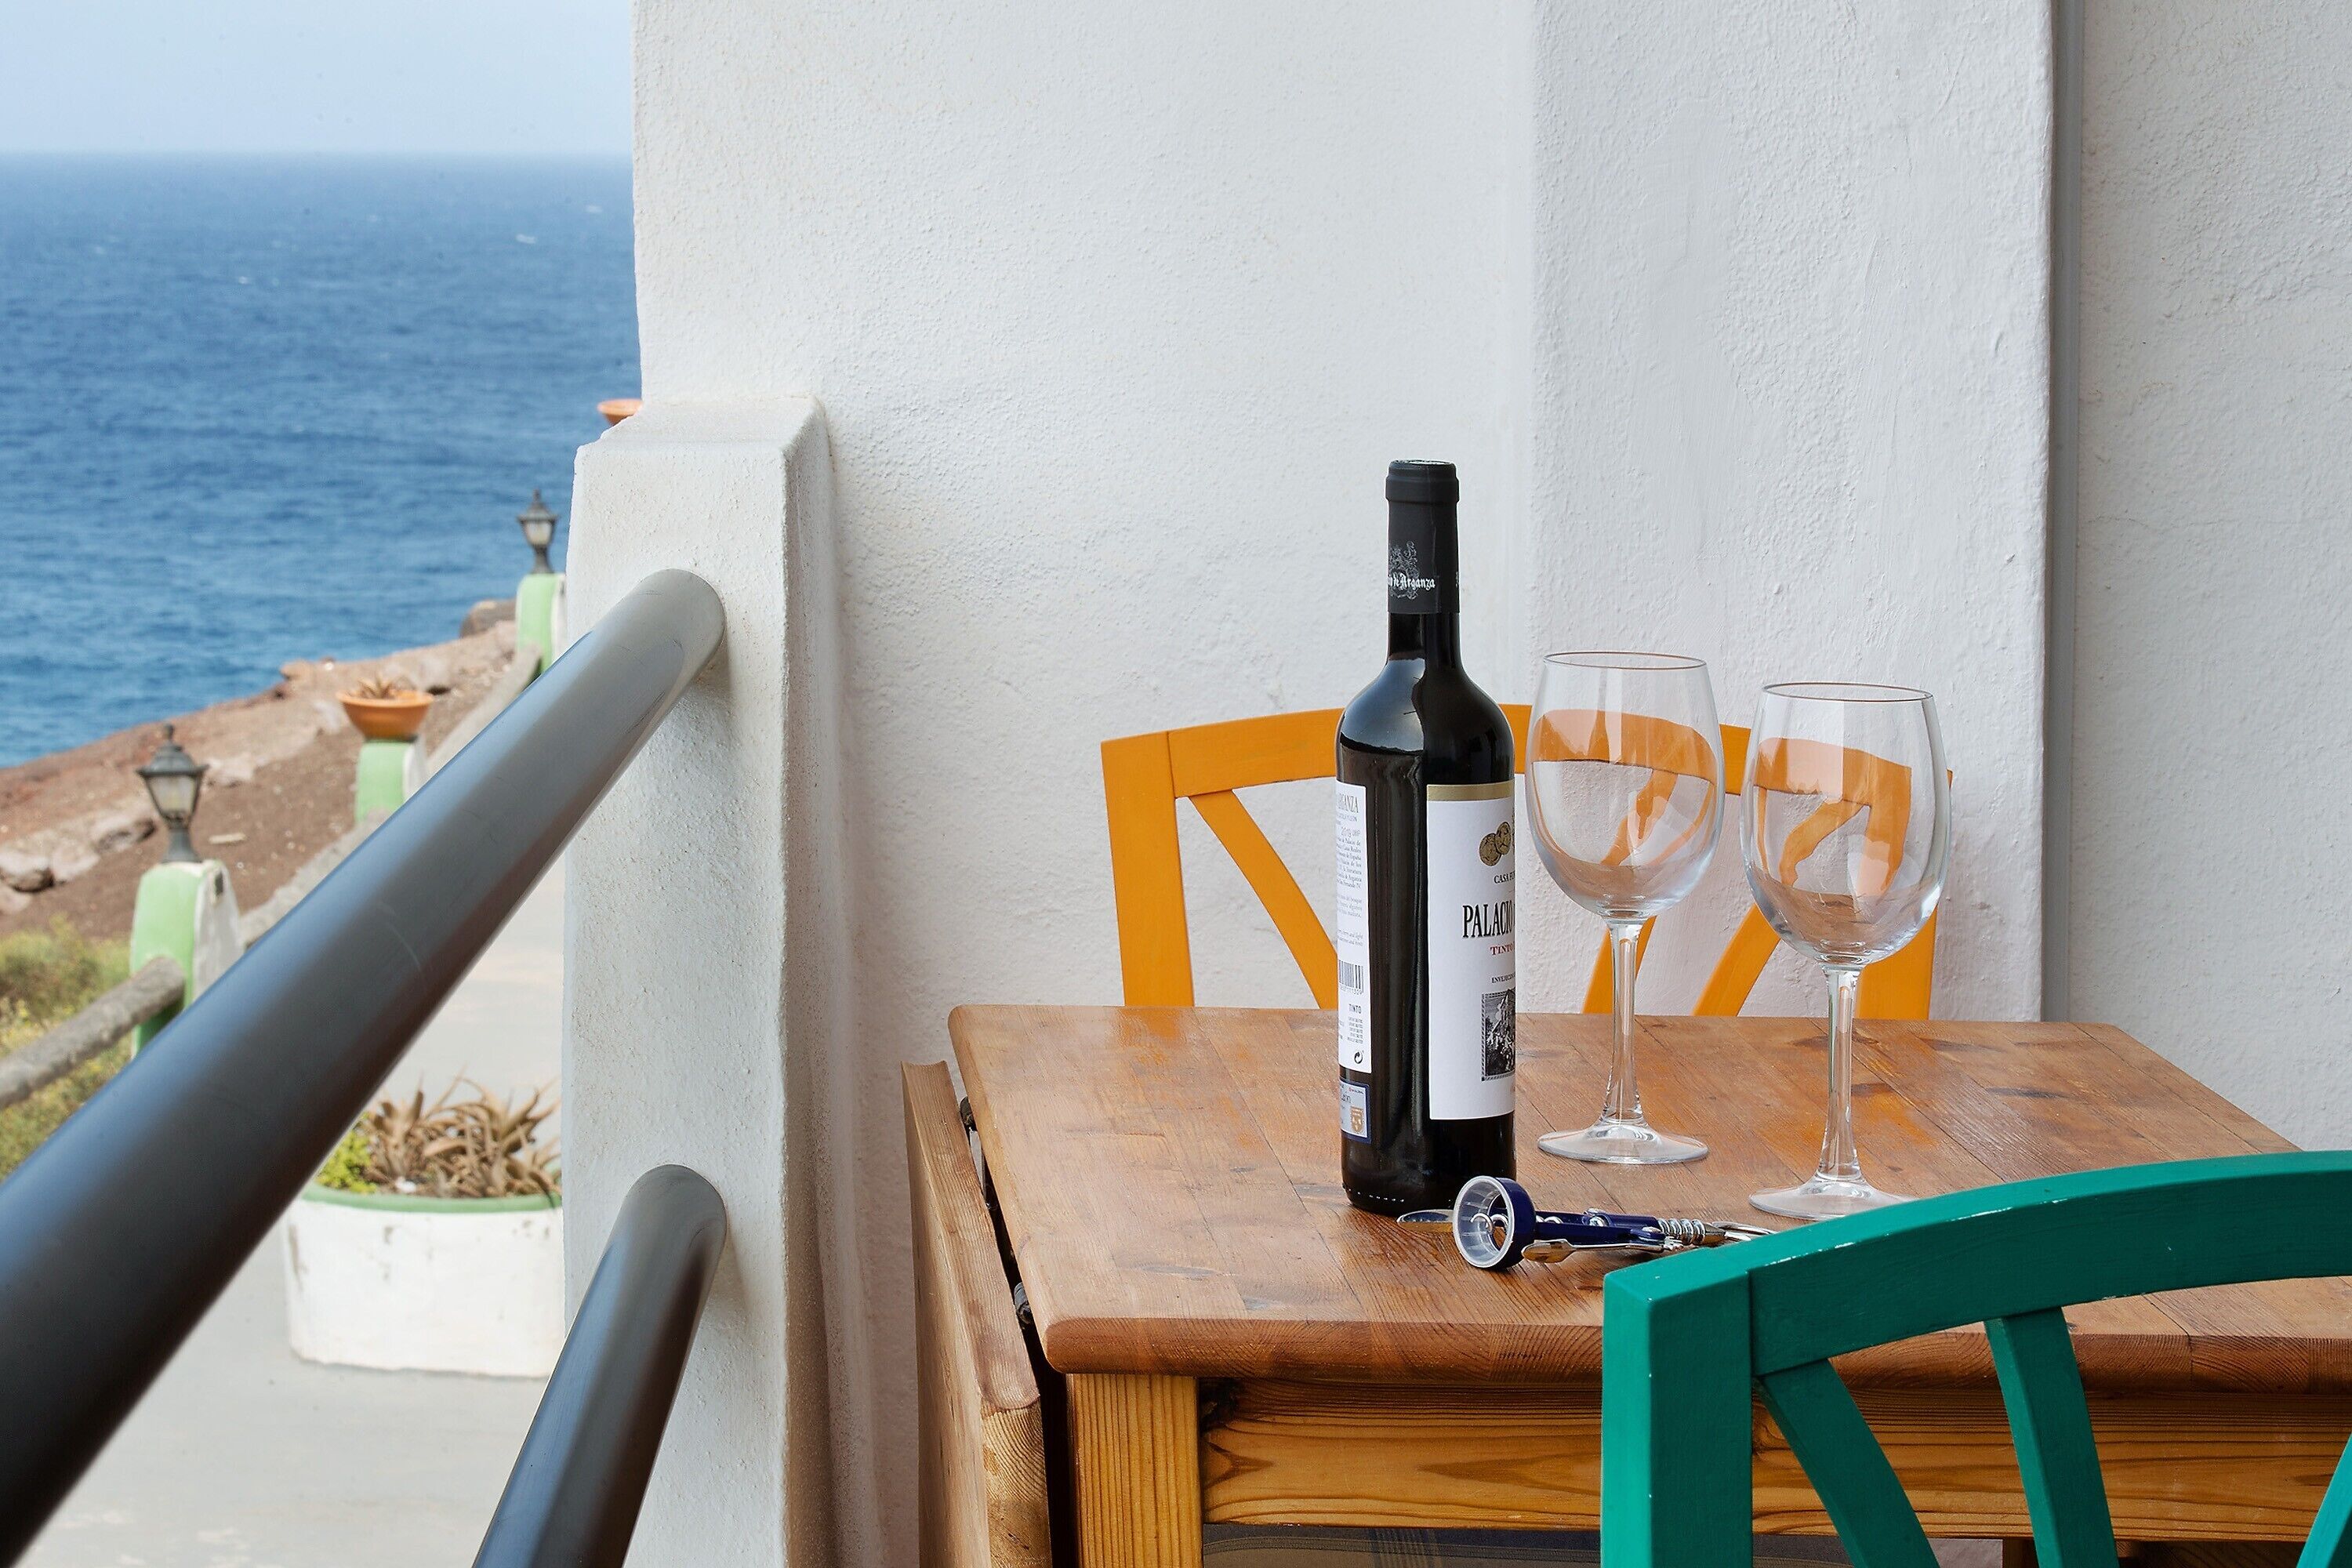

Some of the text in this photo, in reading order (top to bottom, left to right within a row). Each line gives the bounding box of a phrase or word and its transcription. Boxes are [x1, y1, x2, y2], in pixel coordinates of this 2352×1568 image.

[1400, 572, 1436, 591] Arganza
[1463, 900, 1513, 938] PALACIO
[1490, 942, 1513, 956] TINTO
